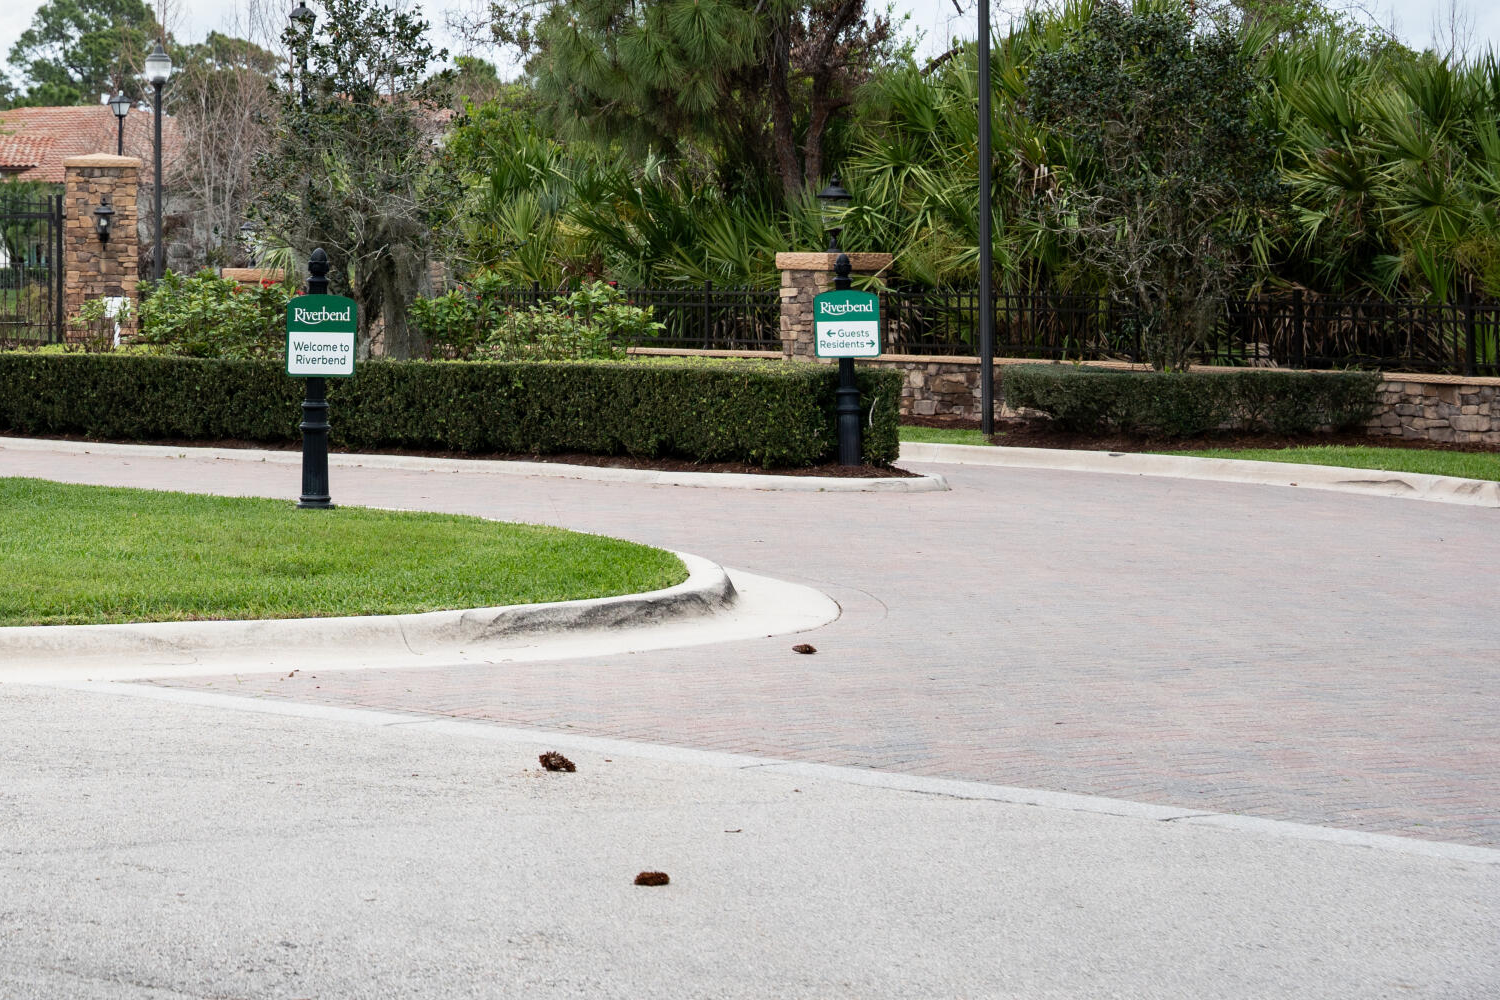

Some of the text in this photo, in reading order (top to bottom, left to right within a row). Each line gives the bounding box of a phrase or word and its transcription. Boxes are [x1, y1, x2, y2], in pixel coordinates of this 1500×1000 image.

[820, 299, 873, 316] Riverbend
[293, 306, 351, 325] Riverbend
[837, 328, 870, 338] Guests
[293, 341, 350, 352] Welcome to
[820, 340, 865, 349] Residents
[295, 354, 347, 365] Riverbend
